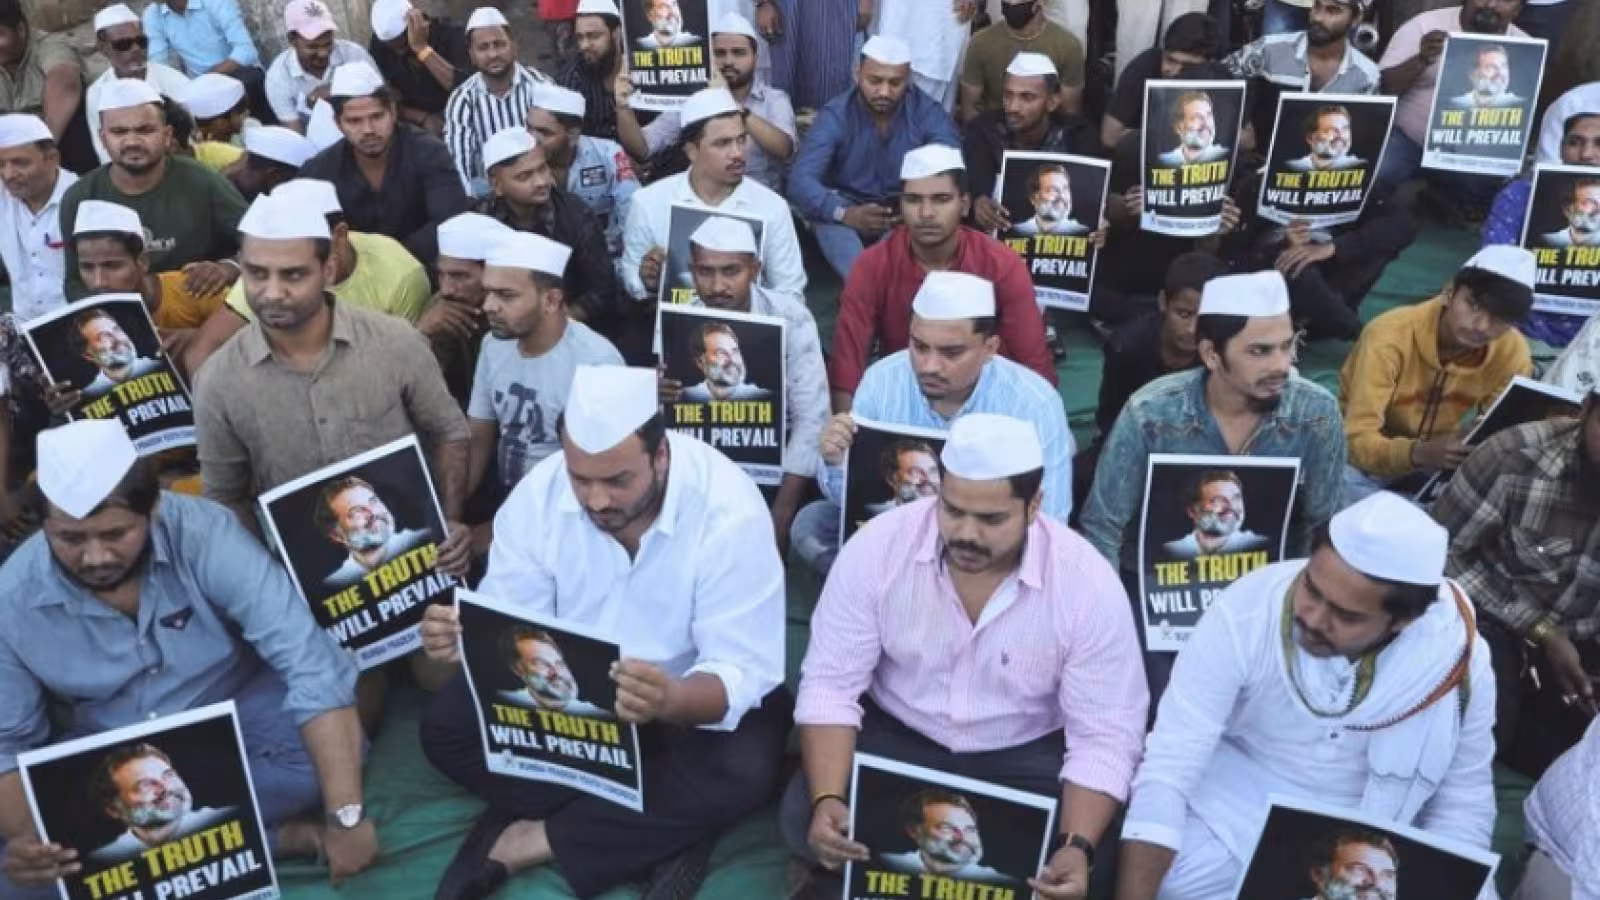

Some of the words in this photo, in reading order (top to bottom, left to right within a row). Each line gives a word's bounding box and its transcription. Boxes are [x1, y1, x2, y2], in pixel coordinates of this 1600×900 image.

[632, 51, 655, 66] THE
[656, 46, 703, 66] TRUTH
[631, 70, 657, 85] WILL
[660, 67, 708, 84] PREVAIL
[1442, 110, 1465, 126] THE
[1470, 107, 1522, 126] TRUTH
[1432, 129, 1461, 143] WILL
[1466, 129, 1520, 144] PREVAIL
[1152, 168, 1176, 186] THE
[1181, 160, 1228, 185] TRUTH
[1276, 172, 1303, 188] THE
[1308, 169, 1366, 188] TRUTH
[1147, 189, 1177, 206] WILL
[1267, 189, 1300, 205] WILL
[1304, 189, 1362, 206] PREVAIL
[1034, 235, 1087, 257] TRUTH
[1032, 259, 1087, 278] PREVAIL
[81, 395, 115, 419] THE
[112, 372, 177, 406] TRUTH
[127, 395, 192, 426] PREVAIL
[673, 404, 704, 423] THE
[709, 401, 771, 423] TRUTH
[711, 428, 778, 447] PREVAIL
[322, 584, 365, 618] THE
[363, 542, 437, 598] TRUTH
[1154, 562, 1190, 585] THE
[325, 609, 378, 643] WILL
[377, 567, 458, 622] PREVAIL
[1149, 590, 1198, 614] WILL
[492, 703, 533, 727] THE
[536, 708, 620, 744] TRUTH
[489, 724, 543, 749] WILL
[545, 734, 634, 770] PREVAIL
[83, 860, 139, 900] THE
[141, 820, 245, 878] TRUTH
[154, 850, 262, 900] PREVAIL
[865, 870, 911, 895] THE
